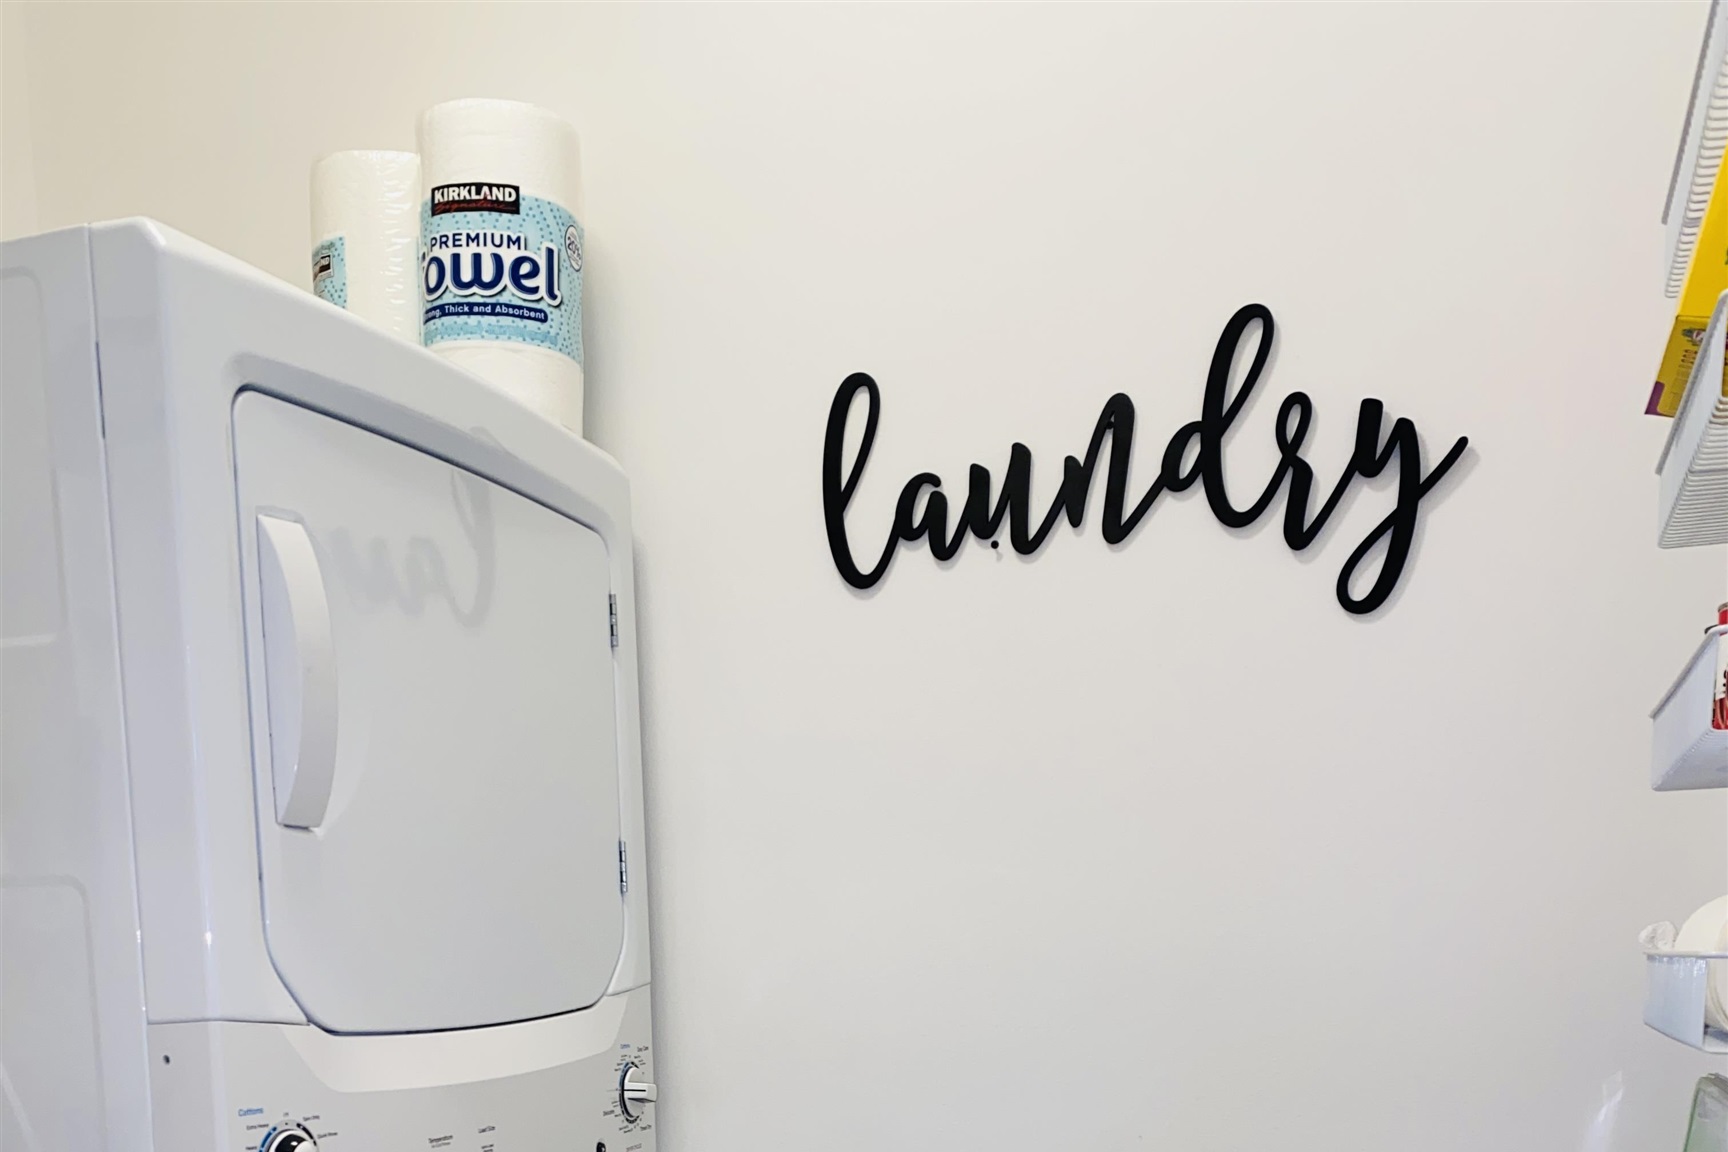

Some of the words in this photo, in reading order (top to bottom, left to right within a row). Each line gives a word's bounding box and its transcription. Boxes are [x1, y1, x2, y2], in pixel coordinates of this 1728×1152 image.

[434, 185, 517, 204] KIRKLAND
[430, 232, 521, 252] PREMIUM
[422, 246, 558, 301] owel
[444, 304, 469, 314] Thick
[473, 304, 492, 313] and
[495, 305, 545, 320] Absorbent
[822, 303, 1469, 615] laundry
